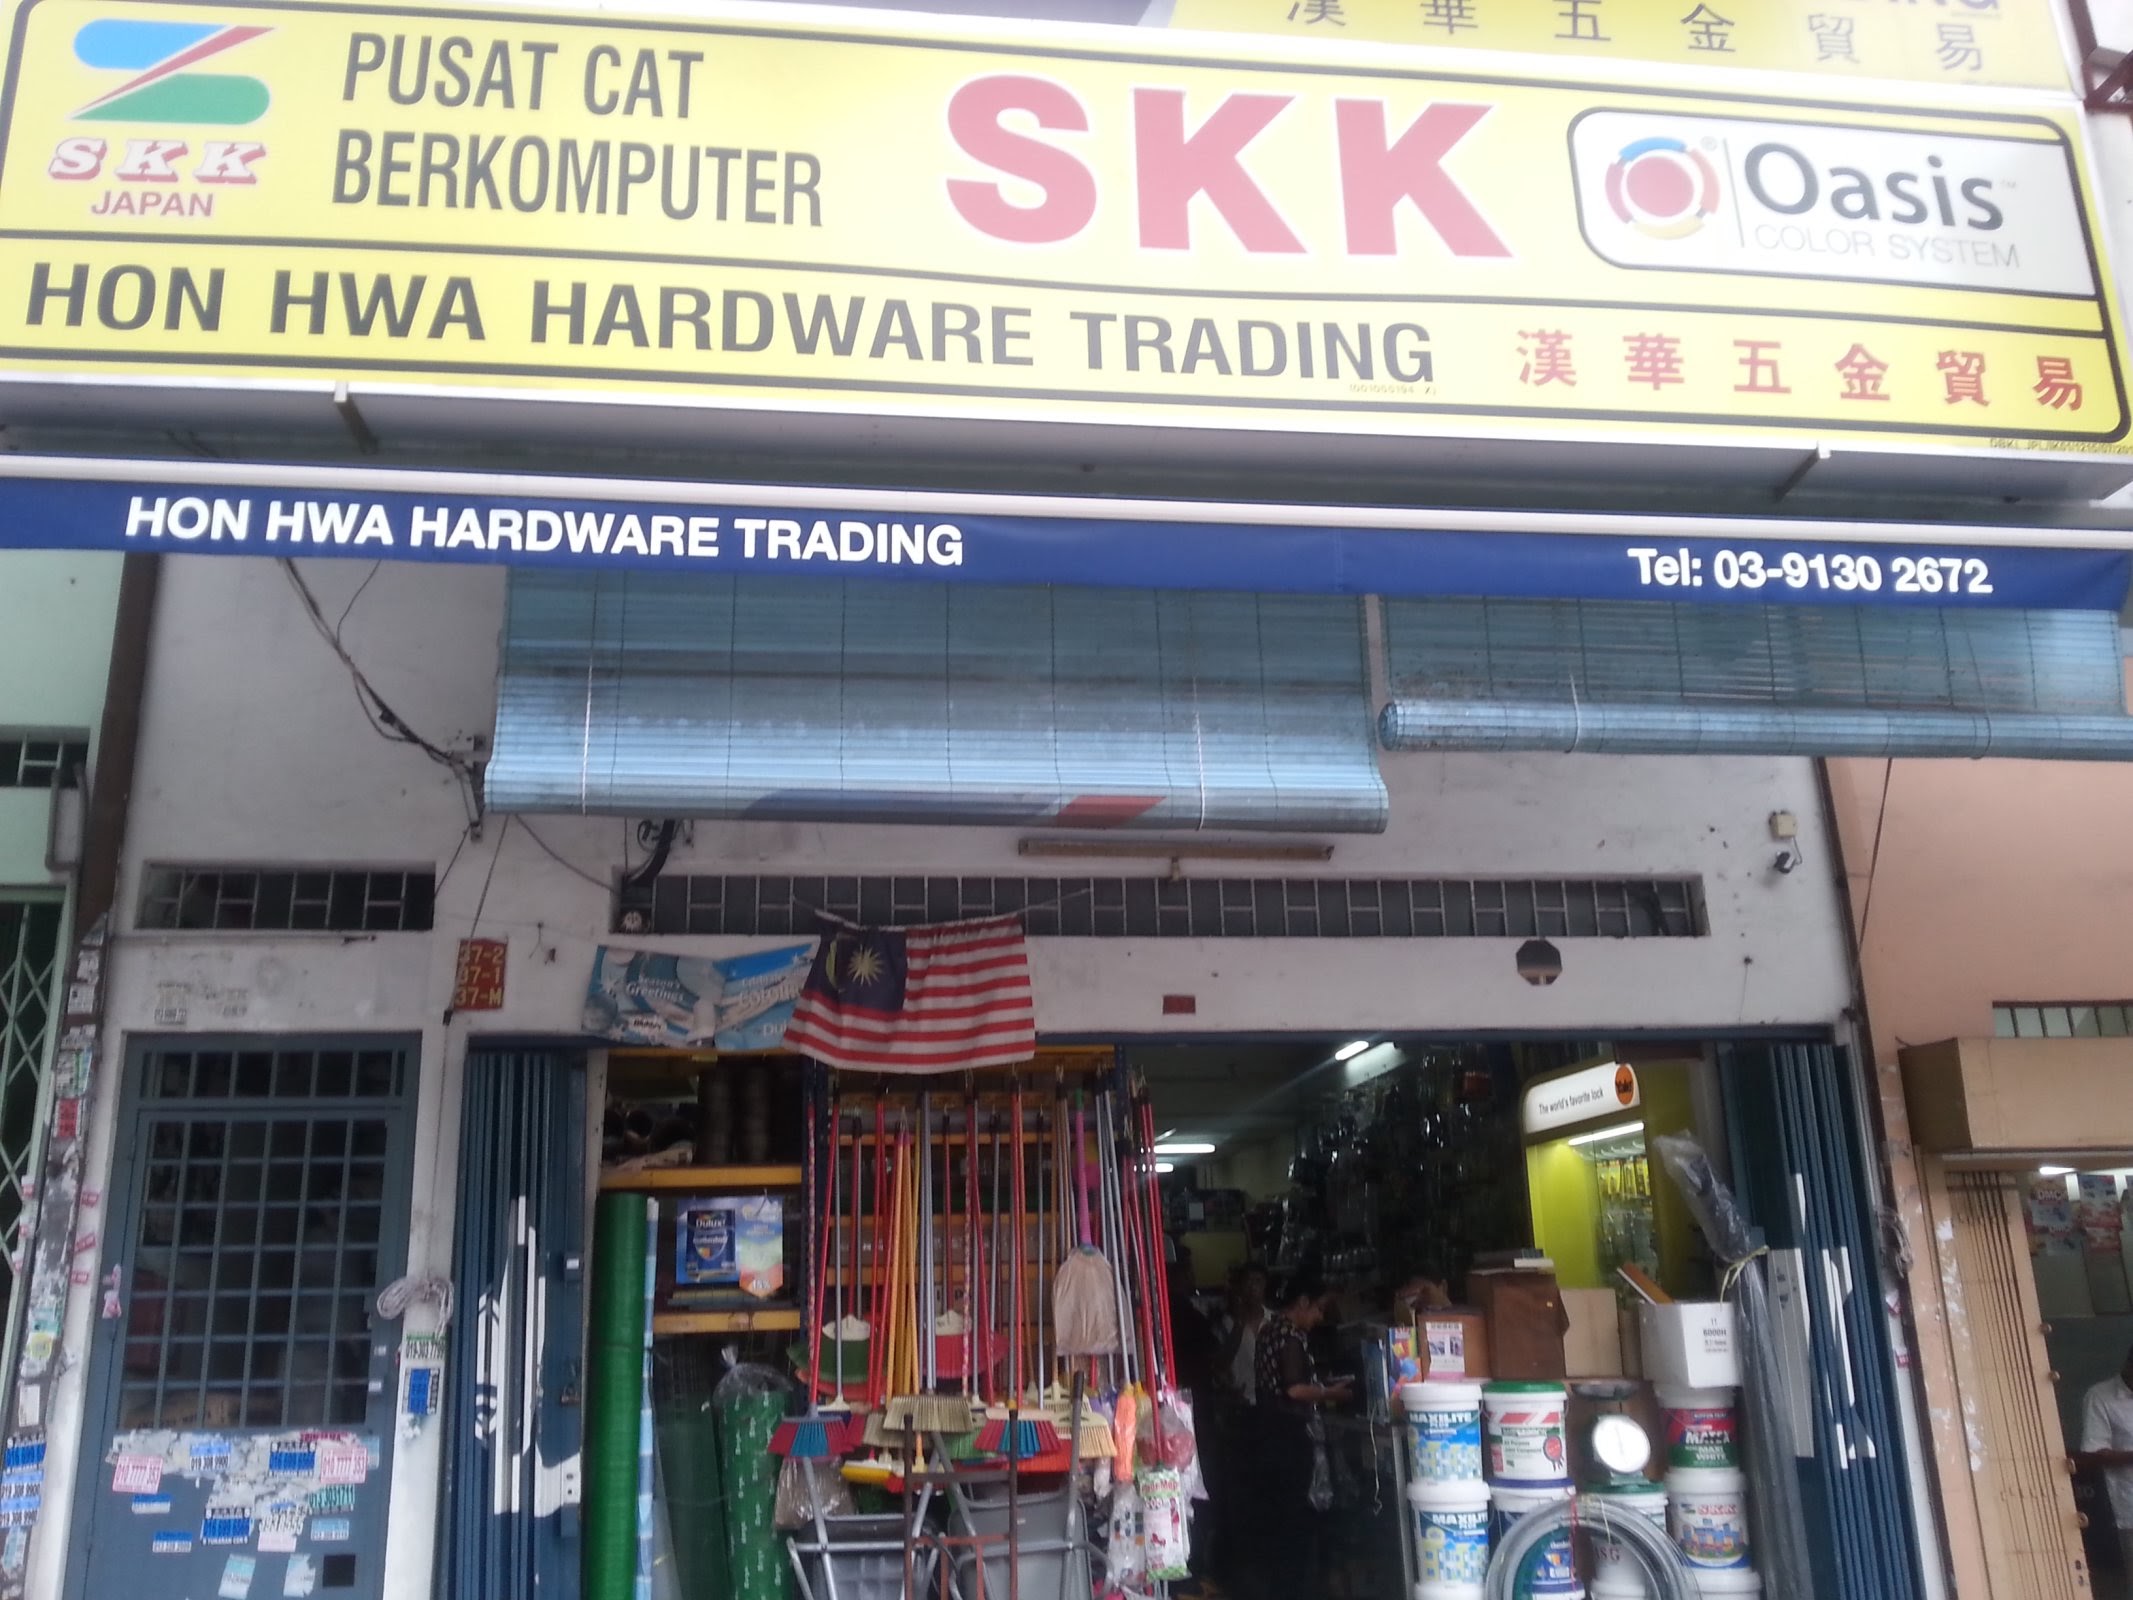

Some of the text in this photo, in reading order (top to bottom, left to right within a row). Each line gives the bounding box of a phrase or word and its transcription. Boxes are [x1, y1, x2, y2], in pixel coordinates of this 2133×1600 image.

[342, 32, 704, 119] PUSAT CAT
[48, 137, 266, 184] SKK
[332, 129, 822, 227] BERKOMPUTER
[946, 74, 1512, 257] SKK
[91, 190, 213, 217] JAPAN
[1744, 142, 2003, 230] Oasis
[1754, 223, 2021, 269] COLOR SYSTEM
[25, 262, 1434, 382] HON HWA HARDWARE TRADING
[1516, 329, 2084, 412] 漢華五金貿易
[126, 496, 964, 568] HON HWA HARDWARE TRADING
[1627, 547, 1993, 594] Tel: 03-9130 2672
[454, 986, 502, 1006] 37-M
[626, 982, 684, 1002] Greetings
[1539, 1087, 1604, 1114] The world's favorite lock
[1409, 1412, 1472, 1423] MAXILITE
